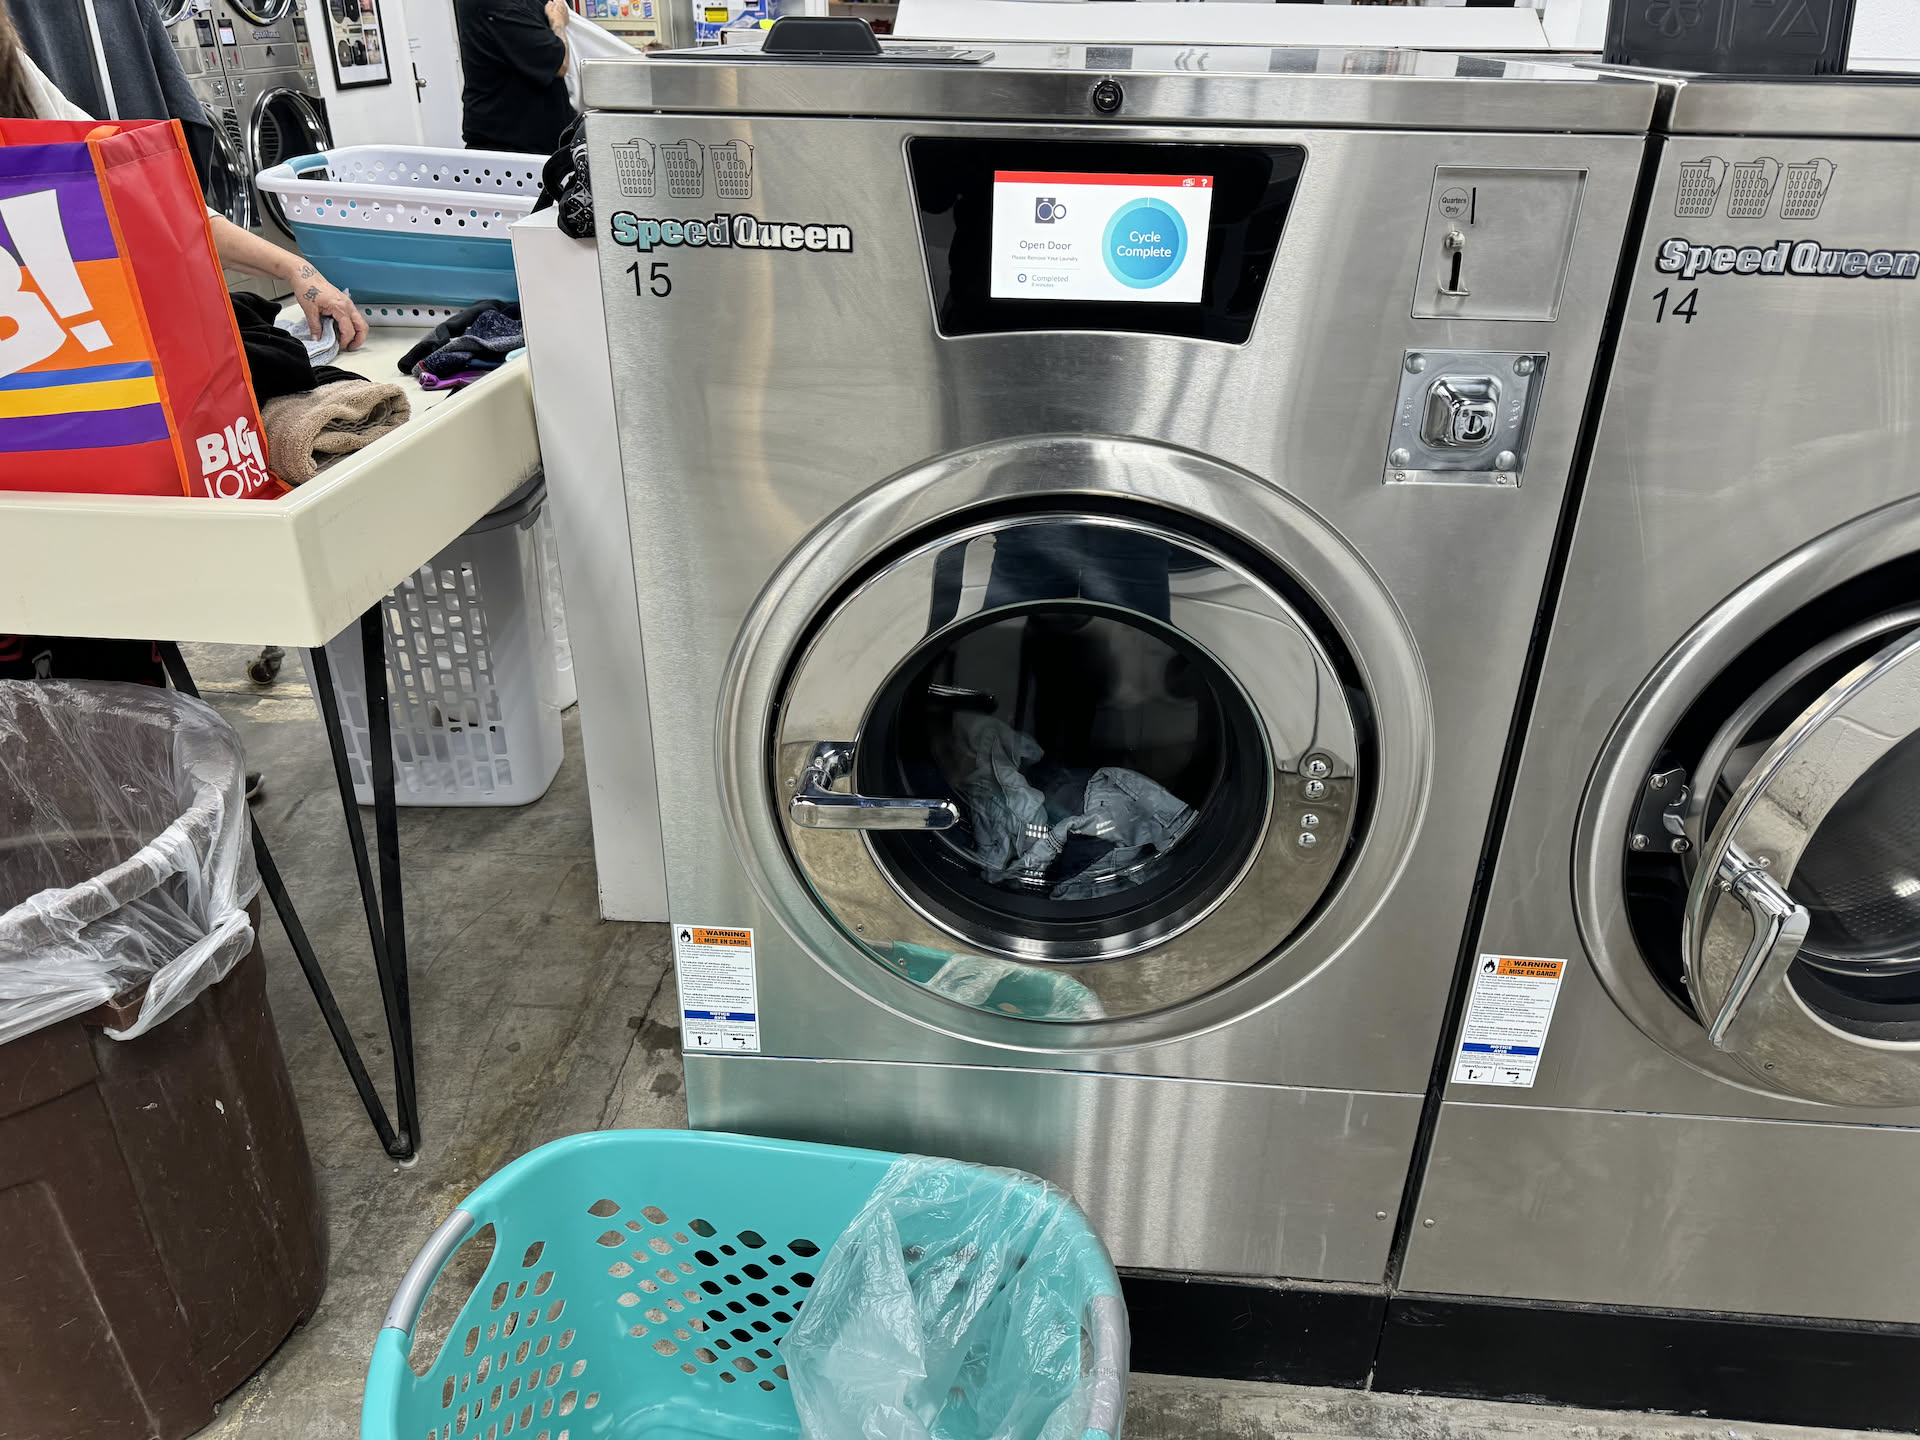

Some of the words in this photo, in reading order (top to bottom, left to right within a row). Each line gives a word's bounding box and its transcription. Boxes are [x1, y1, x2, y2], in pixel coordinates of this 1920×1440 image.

[1445, 206, 1460, 214] Only
[611, 211, 733, 252] Speed
[734, 214, 853, 252] Queen
[1128, 231, 1162, 244] Cycle
[1019, 240, 1045, 251] Open
[1047, 241, 1072, 250] Door
[1116, 245, 1173, 259] Complete
[1656, 238, 1792, 280] Speed
[1790, 240, 1920, 279] Queen
[626, 261, 672, 297] 15
[1031, 274, 1069, 283] Completed
[1652, 287, 1699, 324] 14
[196, 416, 249, 476] BIG
[705, 930, 746, 938] WARNING
[1513, 960, 1557, 969] WARNING
